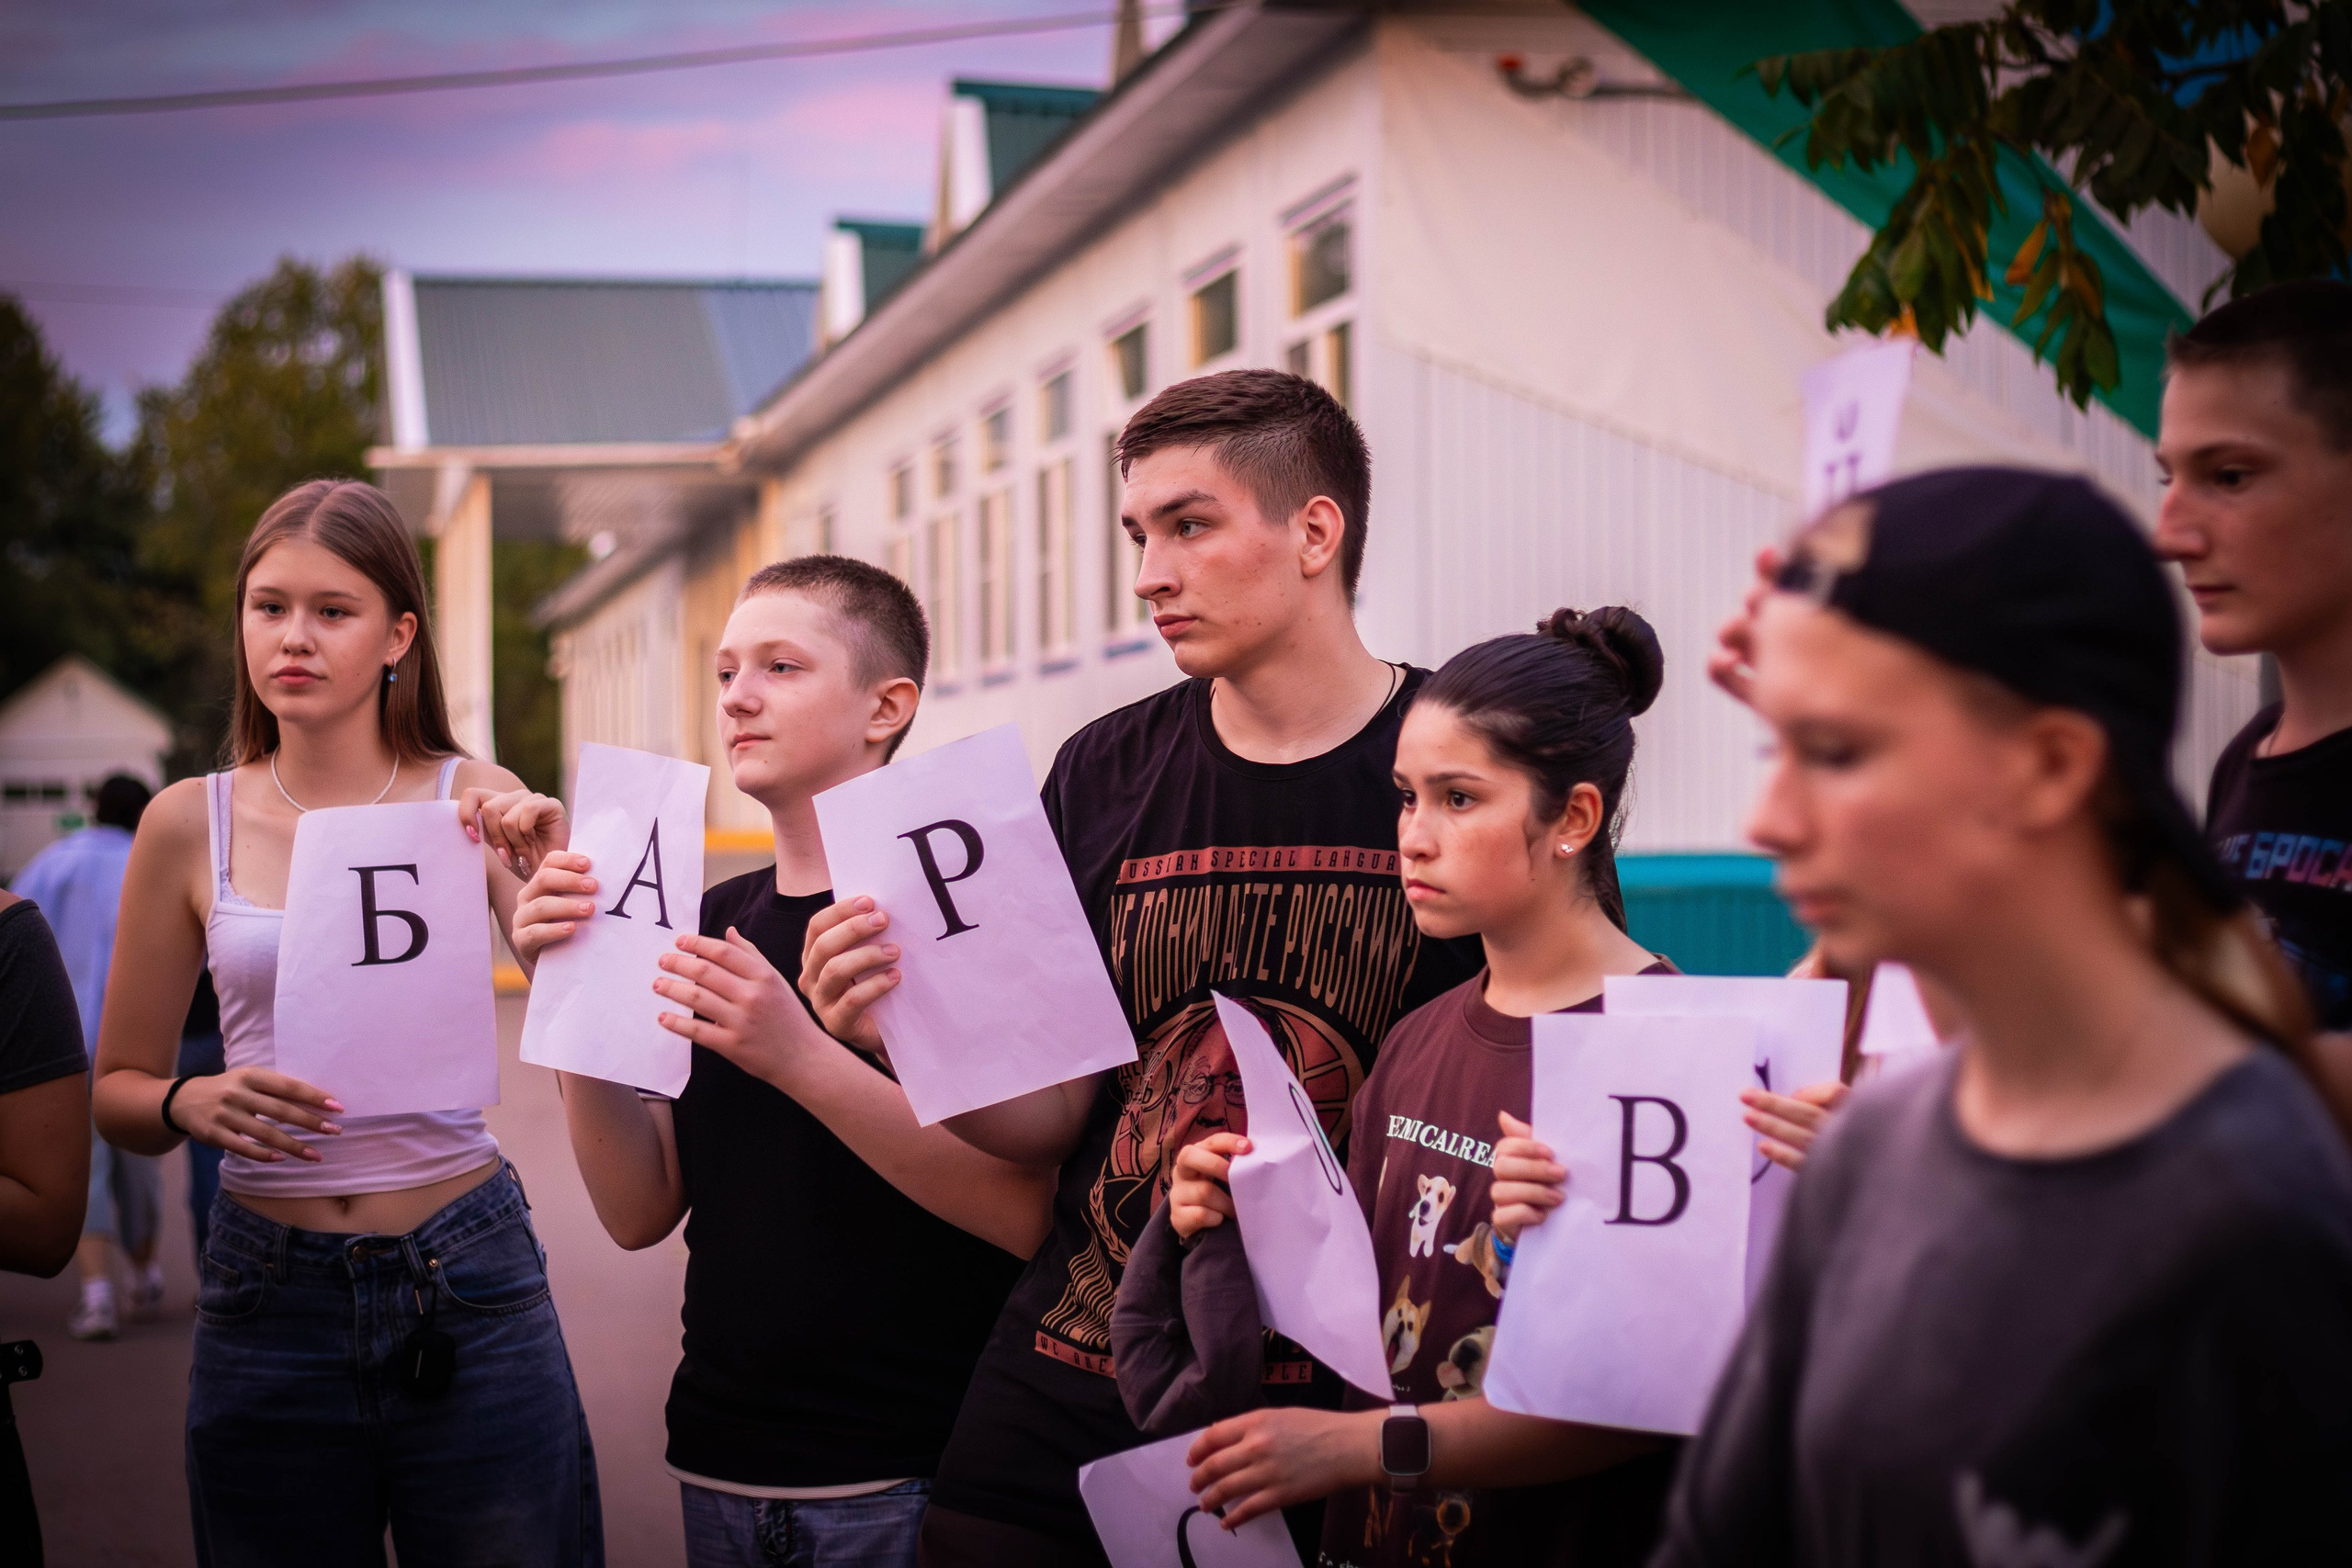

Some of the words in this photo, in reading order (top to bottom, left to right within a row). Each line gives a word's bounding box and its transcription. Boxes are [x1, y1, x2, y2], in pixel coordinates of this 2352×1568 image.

[348, 863, 429, 967] Б
[605, 818, 673, 930] А
[897, 818, 985, 941] Р
[1118, 853, 1199, 880] USSIAN
[1211, 850, 1295, 868] SPECIAL
[1604, 1095, 1691, 1226] В
[1040, 1336, 1059, 1356] WE
[1073, 1351, 1109, 1373] ARE
